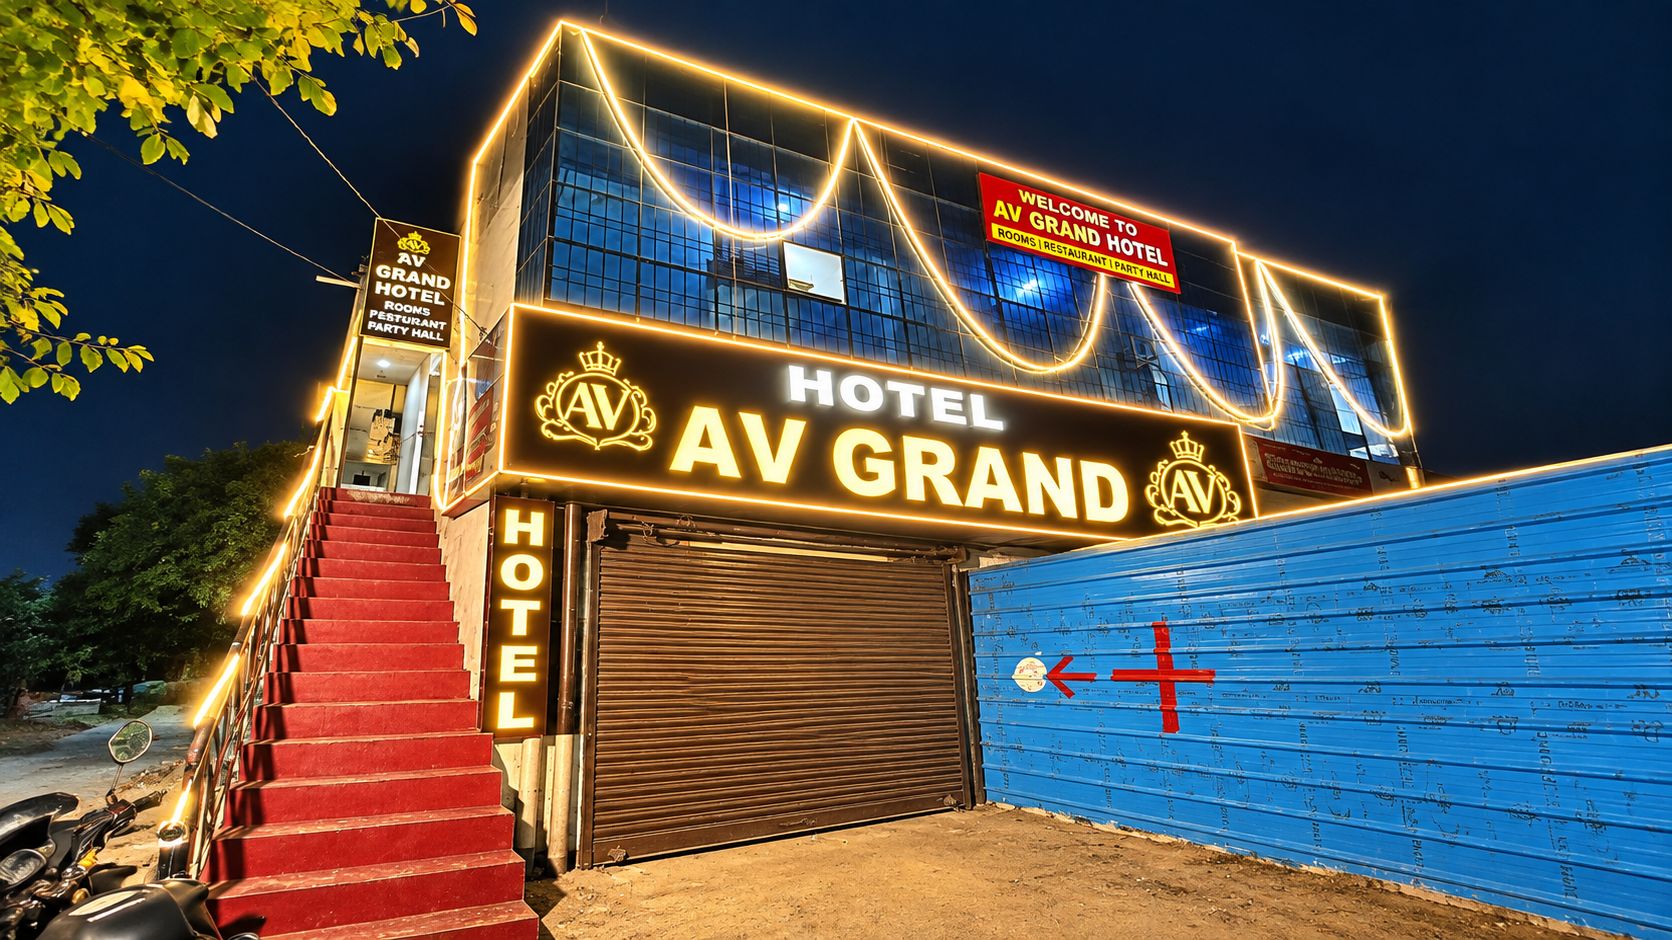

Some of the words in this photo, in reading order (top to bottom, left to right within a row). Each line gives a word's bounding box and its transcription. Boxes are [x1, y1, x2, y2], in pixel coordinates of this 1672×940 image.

[993, 200, 1022, 223] AV
[1029, 212, 1101, 247] GRAND
[1106, 234, 1169, 267] HOTEL
[1018, 189, 1110, 229] WELCOME
[1114, 219, 1138, 237] TO
[375, 264, 451, 290] GRAND
[397, 252, 426, 268] AV
[997, 227, 1037, 247] ROOMS
[1043, 240, 1107, 267] RESTAURANT
[1114, 261, 1144, 277] PARTY
[1146, 272, 1171, 284] HALL
[374, 281, 445, 305] HOTEL
[384, 300, 431, 316] ROOMS
[367, 320, 409, 335] PARTY
[411, 328, 444, 341] HALL
[564, 382, 630, 431] AV
[788, 365, 1005, 432] HOTEL
[669, 405, 807, 484] AV
[832, 428, 1129, 523] GRAND
[1169, 469, 1216, 514] AV
[497, 508, 545, 729] HOTEL
